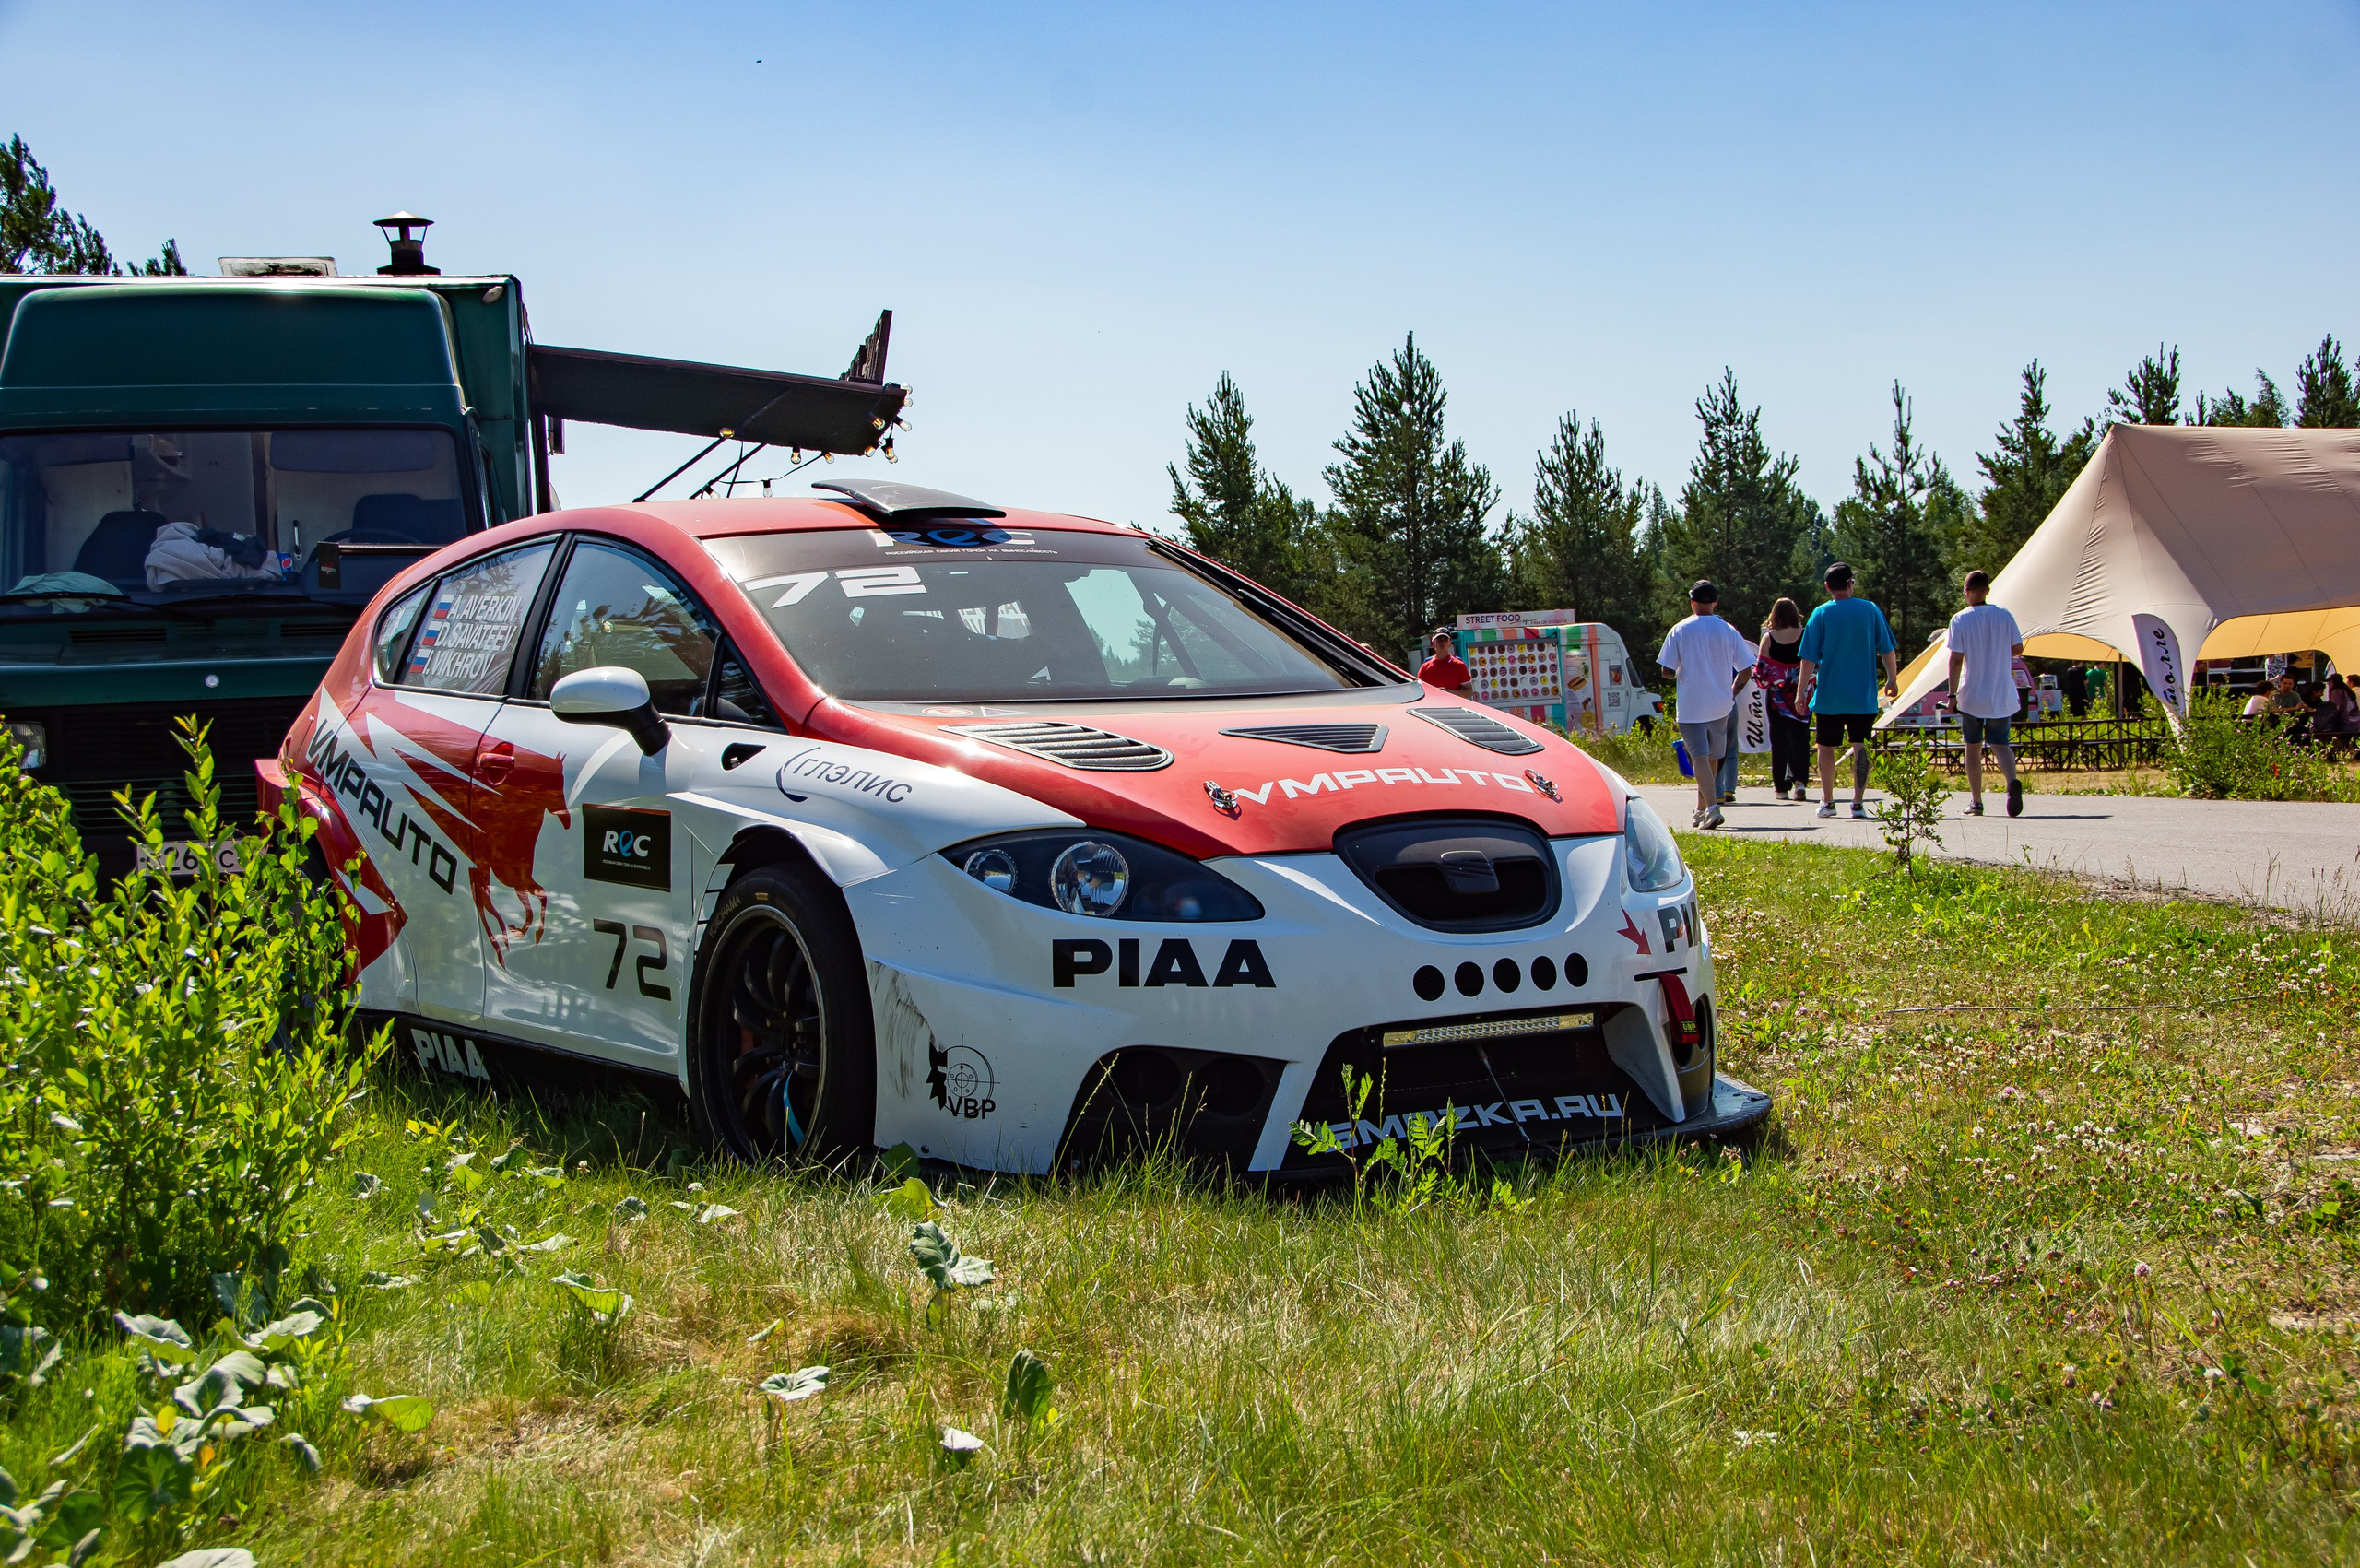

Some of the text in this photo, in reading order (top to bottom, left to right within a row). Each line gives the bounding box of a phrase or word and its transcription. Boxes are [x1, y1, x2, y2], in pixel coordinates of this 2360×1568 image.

[745, 566, 927, 609] 72
[1465, 615, 1495, 624] STREET
[1496, 614, 1521, 623] FOOD
[2153, 627, 2178, 706] толле
[793, 758, 913, 803] ГЛЭЛИС
[1234, 768, 1535, 805] VMPAUTO
[306, 719, 458, 895] VMPAUTO
[593, 918, 672, 1002] 72
[1052, 937, 1278, 988] PIAA
[410, 1028, 491, 1081] PIAA
[948, 1096, 996, 1119] VBP
